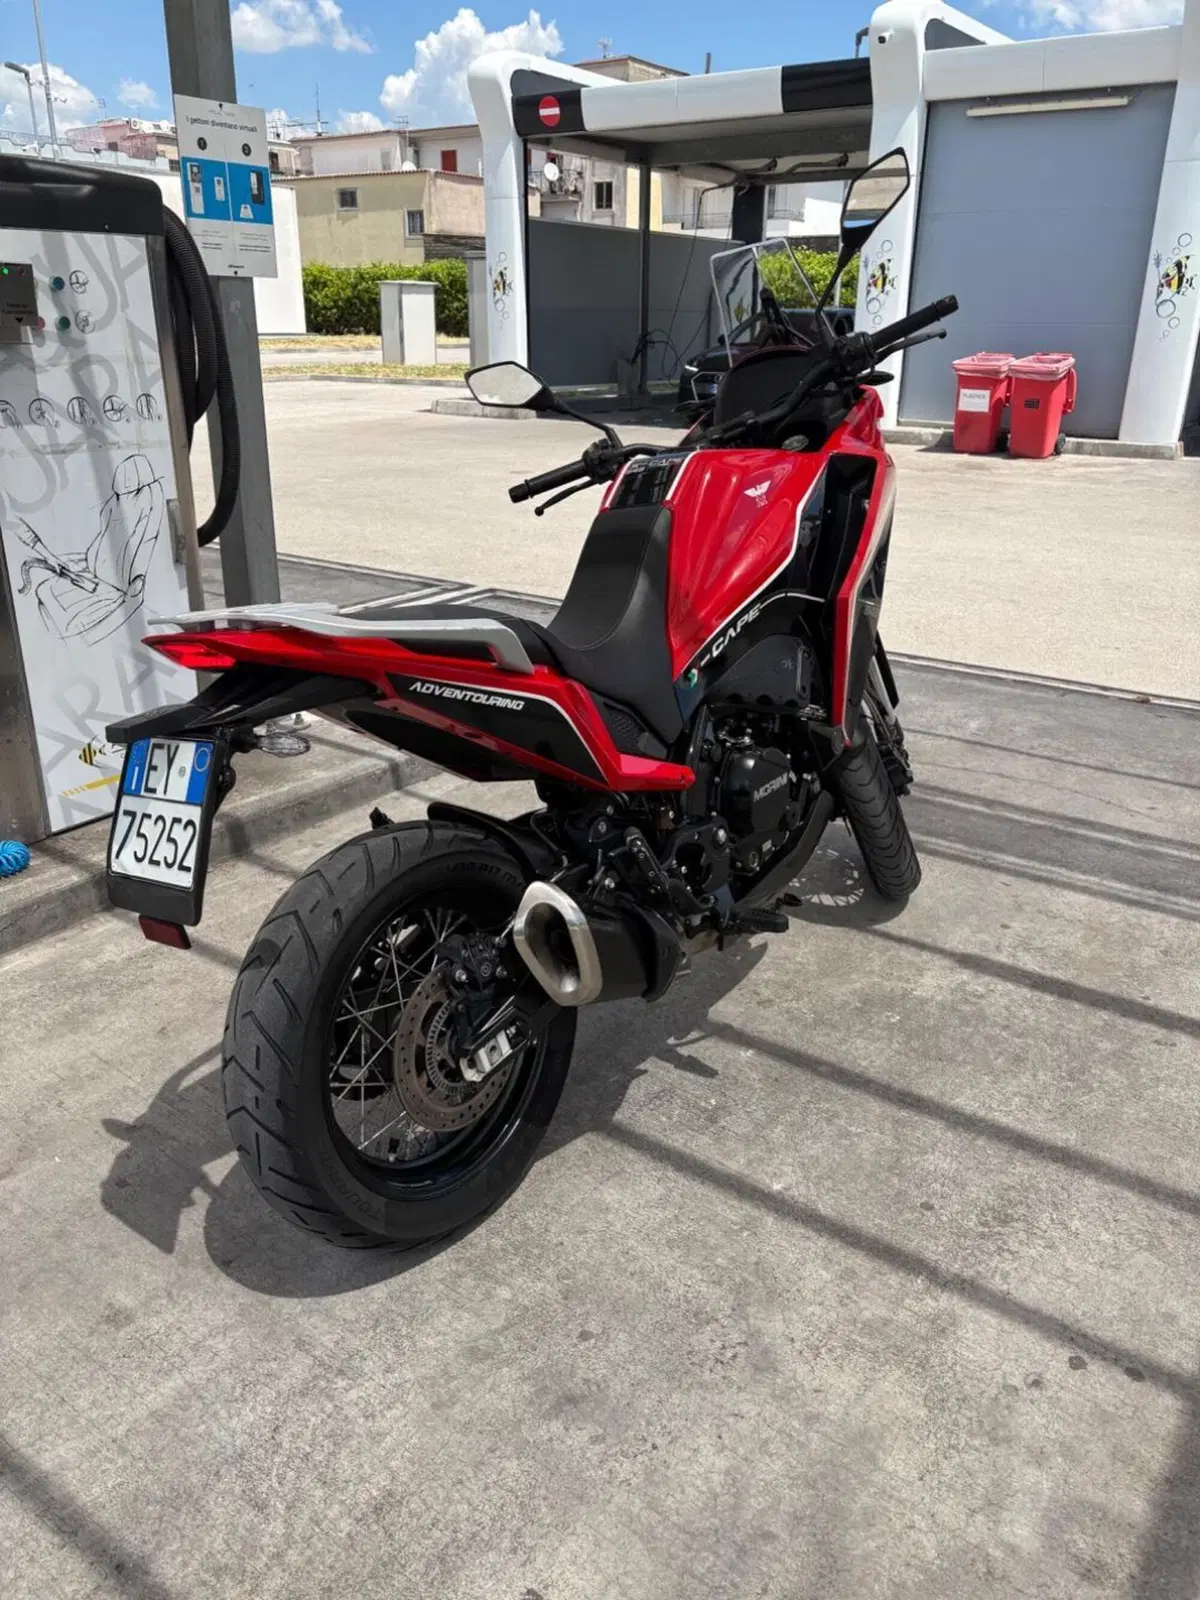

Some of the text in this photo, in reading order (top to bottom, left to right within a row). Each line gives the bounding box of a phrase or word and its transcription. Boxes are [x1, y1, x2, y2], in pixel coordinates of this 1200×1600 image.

[409, 681, 525, 711] ADVENTOURING
[144, 743, 180, 796] EY
[115, 809, 197, 873] 75252
